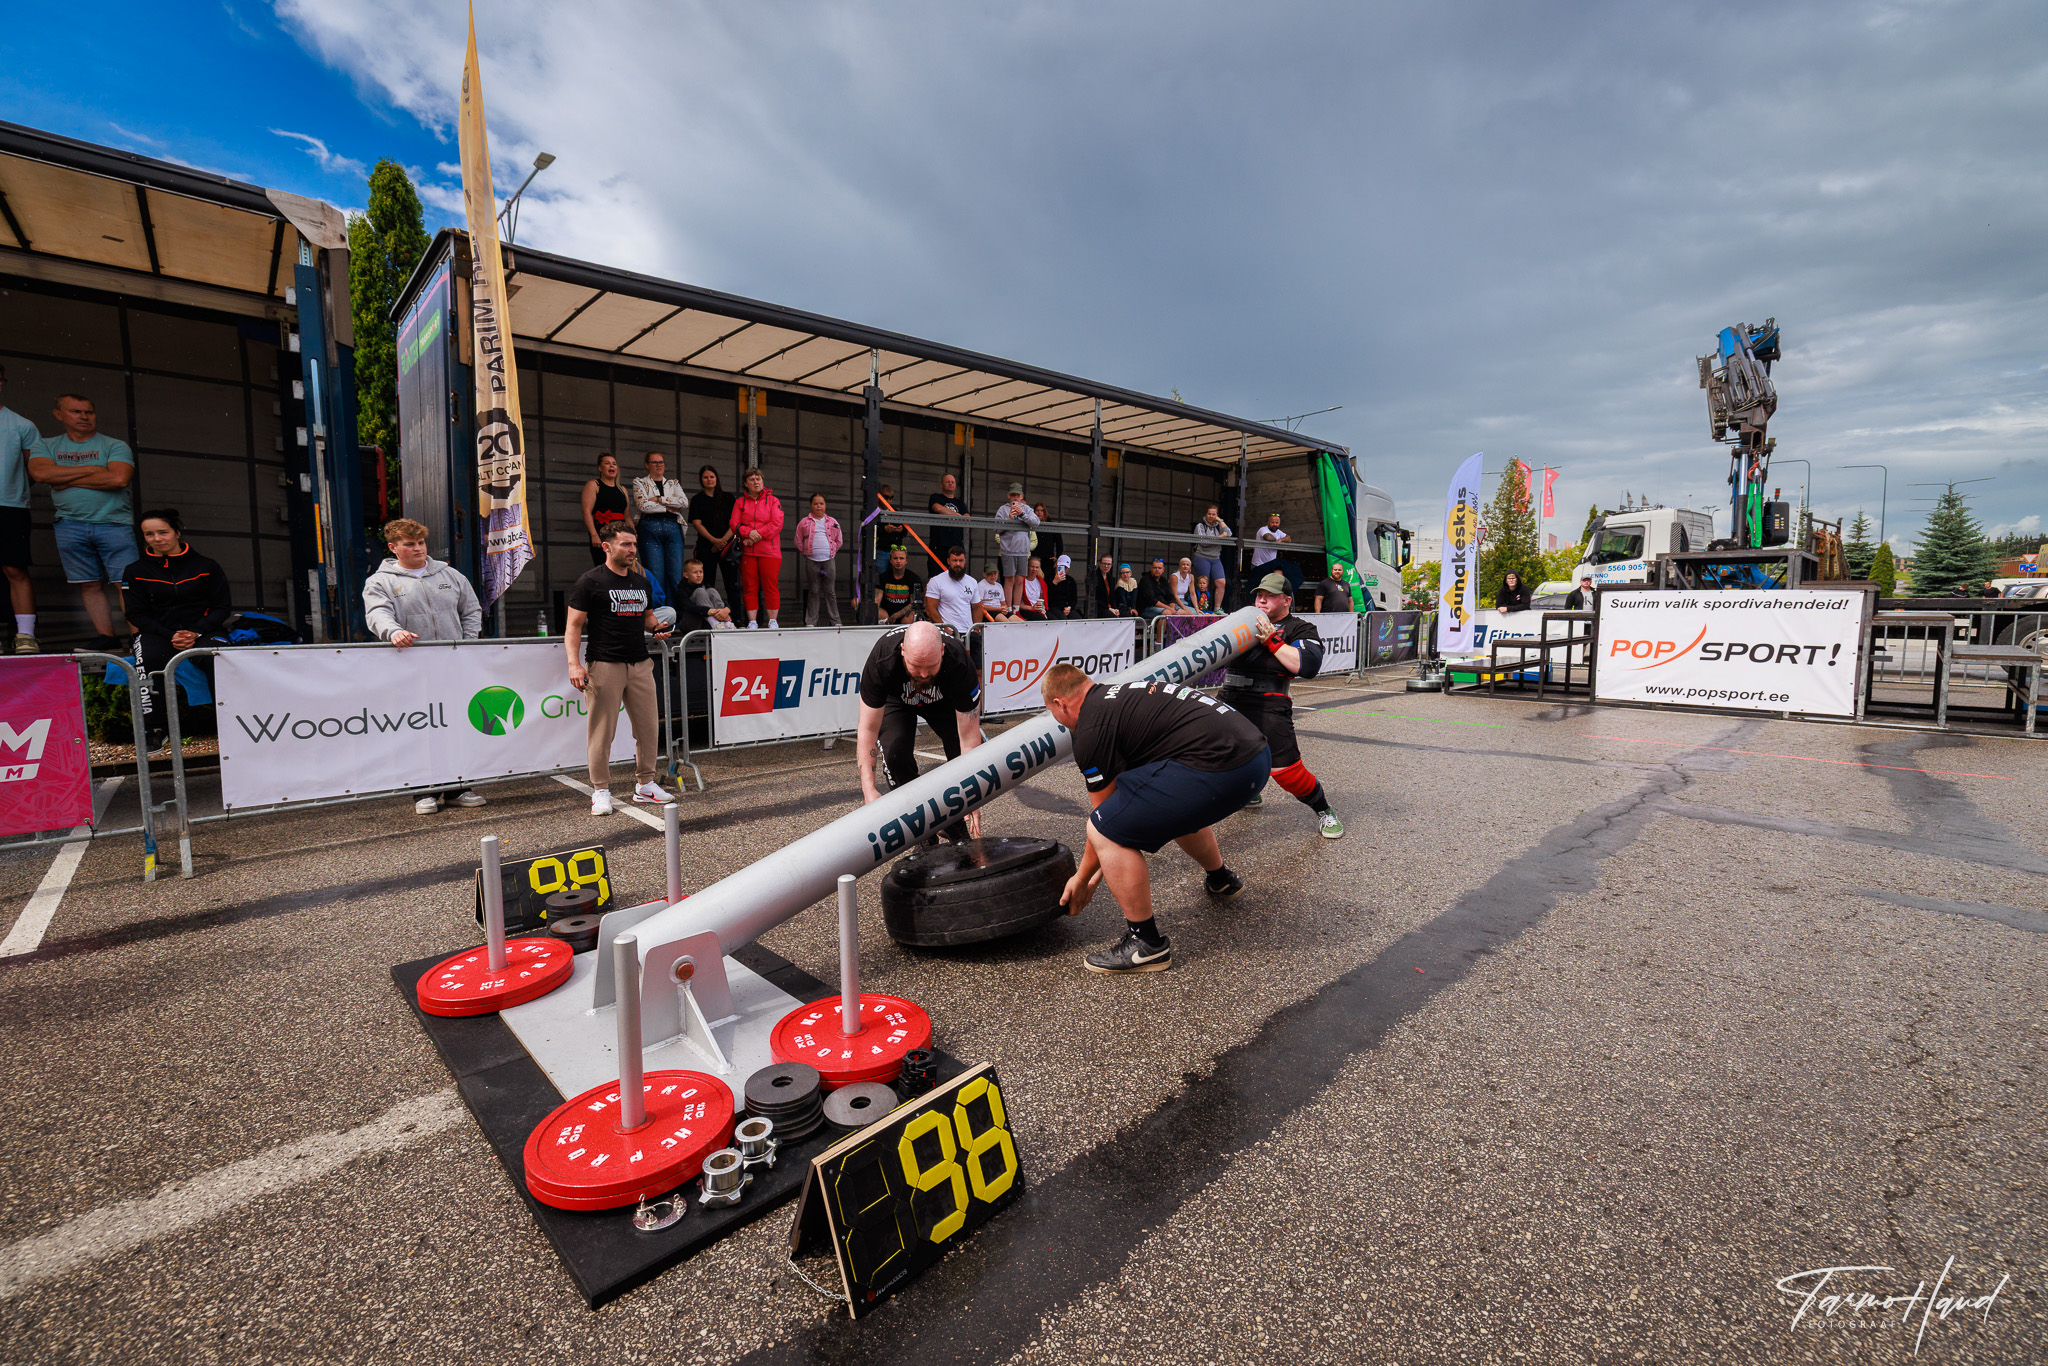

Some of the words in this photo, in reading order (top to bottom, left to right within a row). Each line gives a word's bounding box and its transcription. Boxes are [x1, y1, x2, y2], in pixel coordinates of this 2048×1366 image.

[473, 297, 507, 395] PARIM
[1449, 486, 1467, 632] Lõunakeskus
[1607, 564, 1626, 572] 5560
[1628, 563, 1647, 571] 9057
[1610, 598, 1660, 609] Suurim
[1664, 598, 1699, 609] valik
[1702, 598, 1849, 610] spordivahendeid!
[1474, 632, 1483, 643] 7
[1610, 639, 1676, 659] POP
[1699, 642, 1842, 667] SPORT!
[989, 658, 1039, 684] POP
[135, 665, 153, 715] ESONIA
[730, 674, 770, 702] 24
[782, 675, 798, 698] 7
[808, 667, 862, 698] Fitn
[1645, 685, 1790, 703] www.popsport.ee
[235, 702, 449, 743] Woodwell
[1005, 732, 1057, 780] MIS
[867, 763, 1001, 862] KESTAB!
[800, 1012, 823, 1026] HC
[886, 1028, 909, 1044] HC
[816, 1045, 884, 1059] PRO
[587, 1092, 621, 1112] HC
[684, 1101, 706, 1113] 25
[682, 1110, 705, 1121] KG
[556, 1133, 581, 1147] KG
[559, 1123, 586, 1137] 25
[660, 1127, 693, 1150] HC
[567, 1148, 645, 1168] PRO
[897, 1075, 1019, 1245] 98
